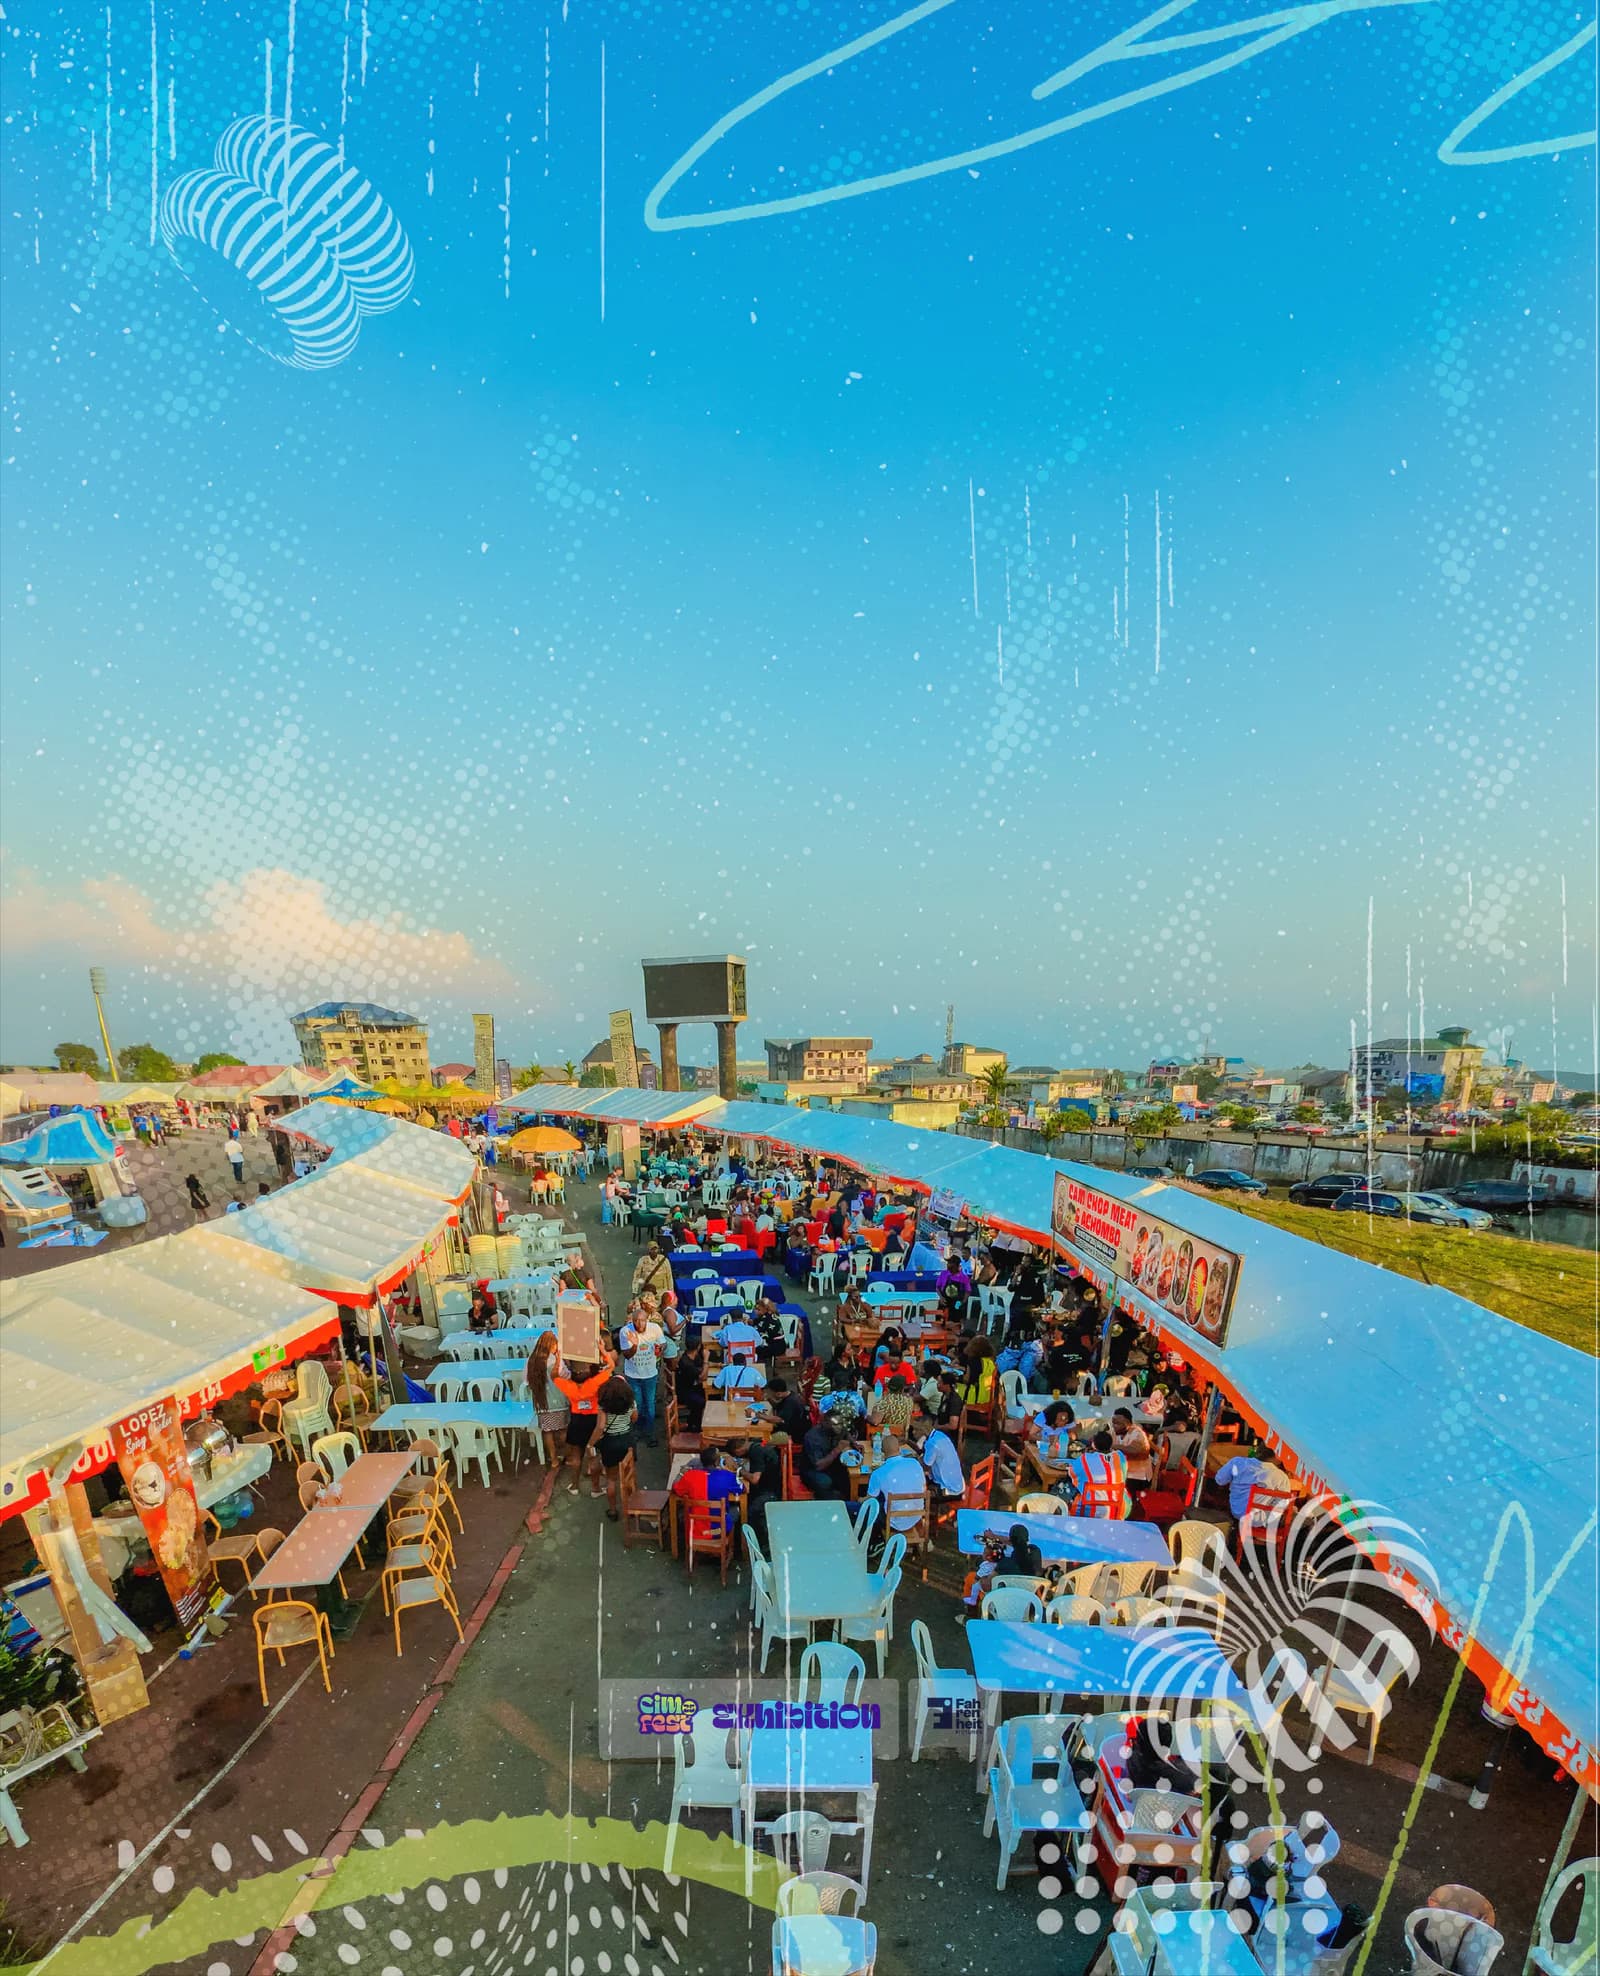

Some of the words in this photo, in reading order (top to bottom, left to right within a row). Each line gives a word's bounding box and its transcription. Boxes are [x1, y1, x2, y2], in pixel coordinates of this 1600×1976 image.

[1068, 1183, 1087, 1206] CAM
[1086, 1191, 1110, 1217] CHOP
[1110, 1202, 1139, 1233] MEAT
[1080, 1209, 1122, 1248] ACHOMBO
[119, 1403, 167, 1438] LOPEZ
